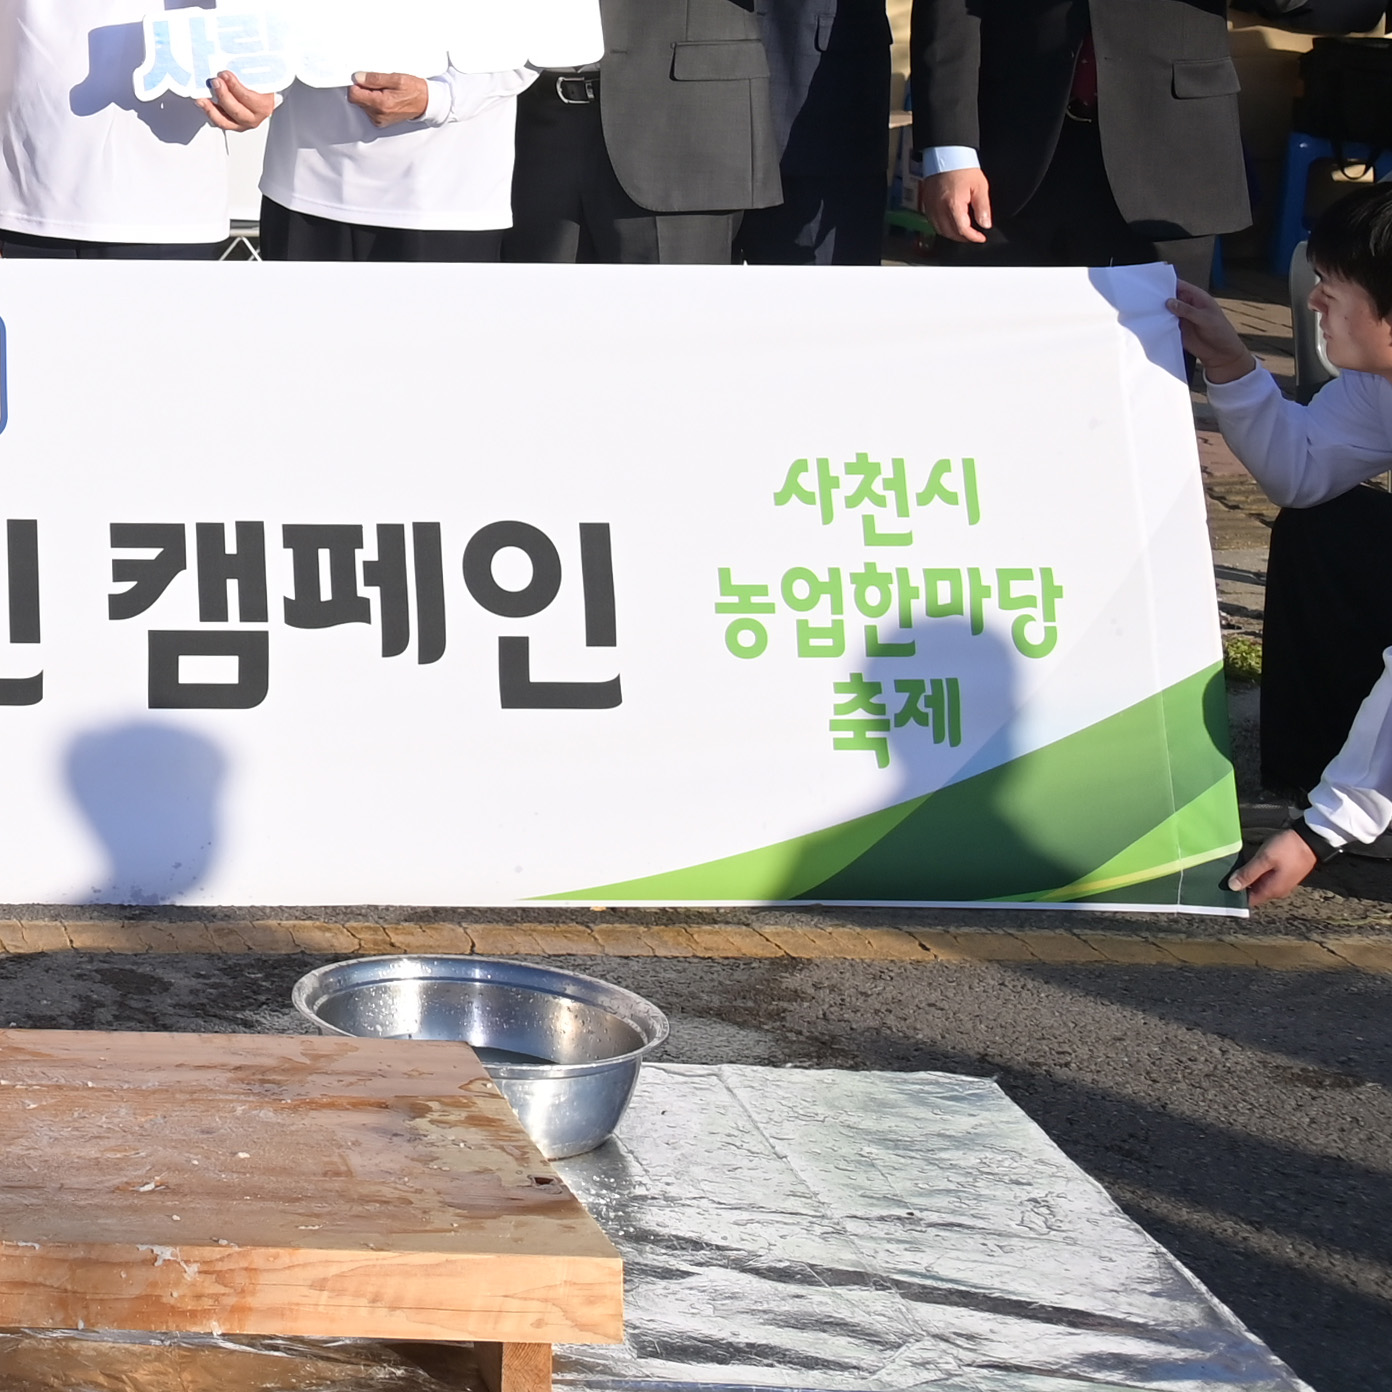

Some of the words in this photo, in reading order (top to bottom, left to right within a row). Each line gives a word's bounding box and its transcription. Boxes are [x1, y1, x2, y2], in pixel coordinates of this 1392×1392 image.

[773, 451, 981, 547] 사천시
[107, 519, 623, 710] 캠페인
[714, 561, 1064, 660] 농업한마당
[828, 672, 962, 769] 축제
